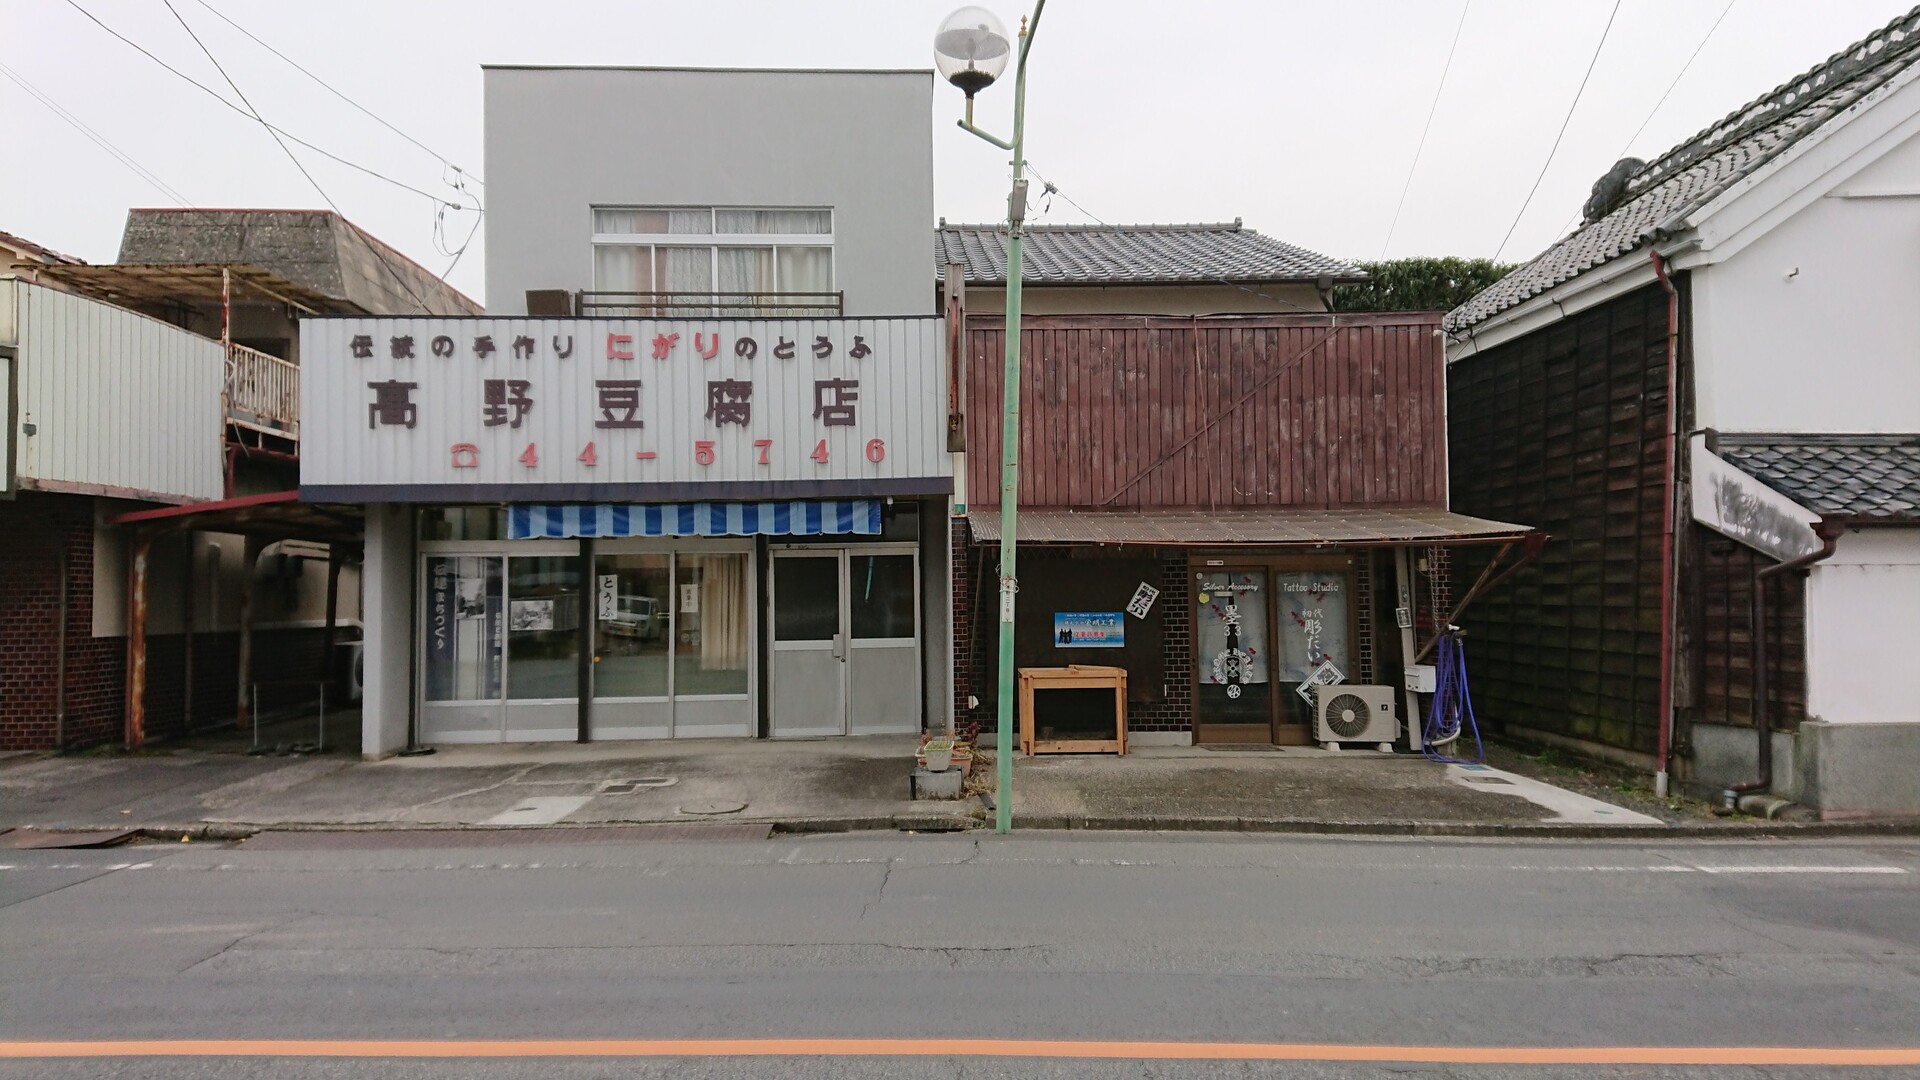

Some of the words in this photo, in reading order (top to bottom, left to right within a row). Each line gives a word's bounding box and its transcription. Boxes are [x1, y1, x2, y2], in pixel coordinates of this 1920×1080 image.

[367, 377, 859, 430] 高野豆腐店
[601, 576, 614, 617] とうふ
[1202, 582, 1225, 591] Silver
[1283, 583, 1308, 592] Tattoo
[1312, 583, 1339, 592] Studio
[1224, 604, 1242, 625] 墨
[1302, 608, 1324, 619] 初代
[1303, 619, 1323, 662] 彫だい
